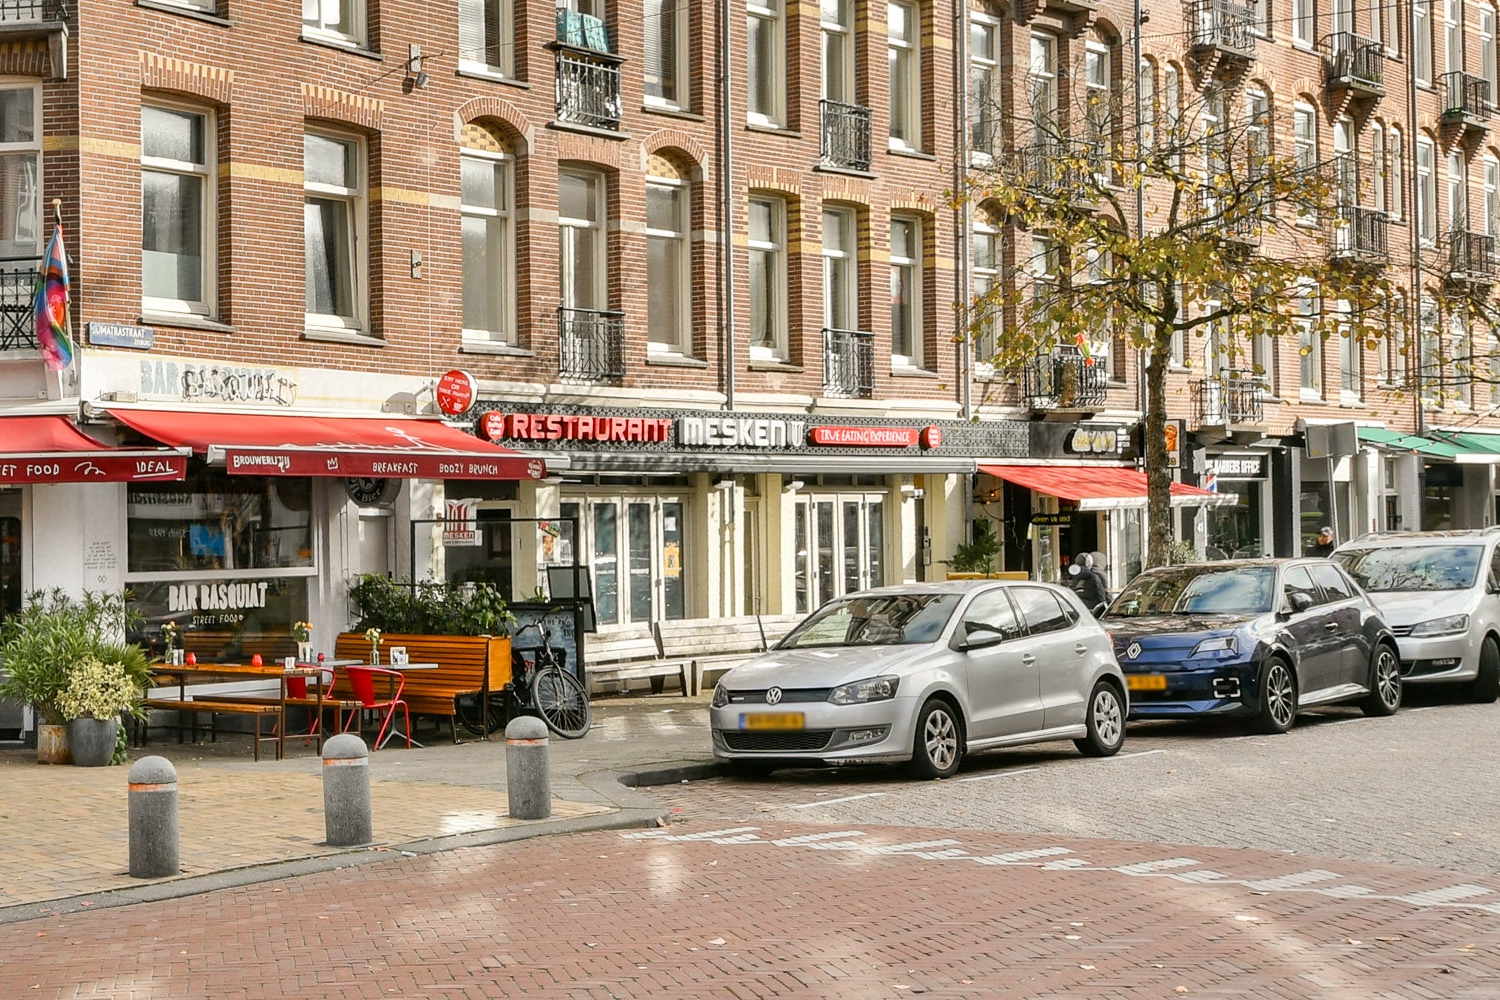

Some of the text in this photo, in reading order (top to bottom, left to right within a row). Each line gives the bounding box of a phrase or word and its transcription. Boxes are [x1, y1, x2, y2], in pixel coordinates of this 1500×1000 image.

[140, 360, 180, 395] BAR
[512, 413, 787, 447] RESTAURANT MESKEN
[841, 430, 868, 443] EATING
[870, 431, 910, 443] EXPERIENCE
[26, 463, 60, 476] FOOD
[136, 461, 174, 474] IDEAL
[372, 462, 498, 476] BREAKFAST BOOZY BRUNCH
[1241, 459, 1261, 474] OFFICE
[443, 531, 475, 540] MESKEN
[168, 582, 268, 612] BAR BASQUIAT
[192, 614, 239, 625] STREET FOOD
